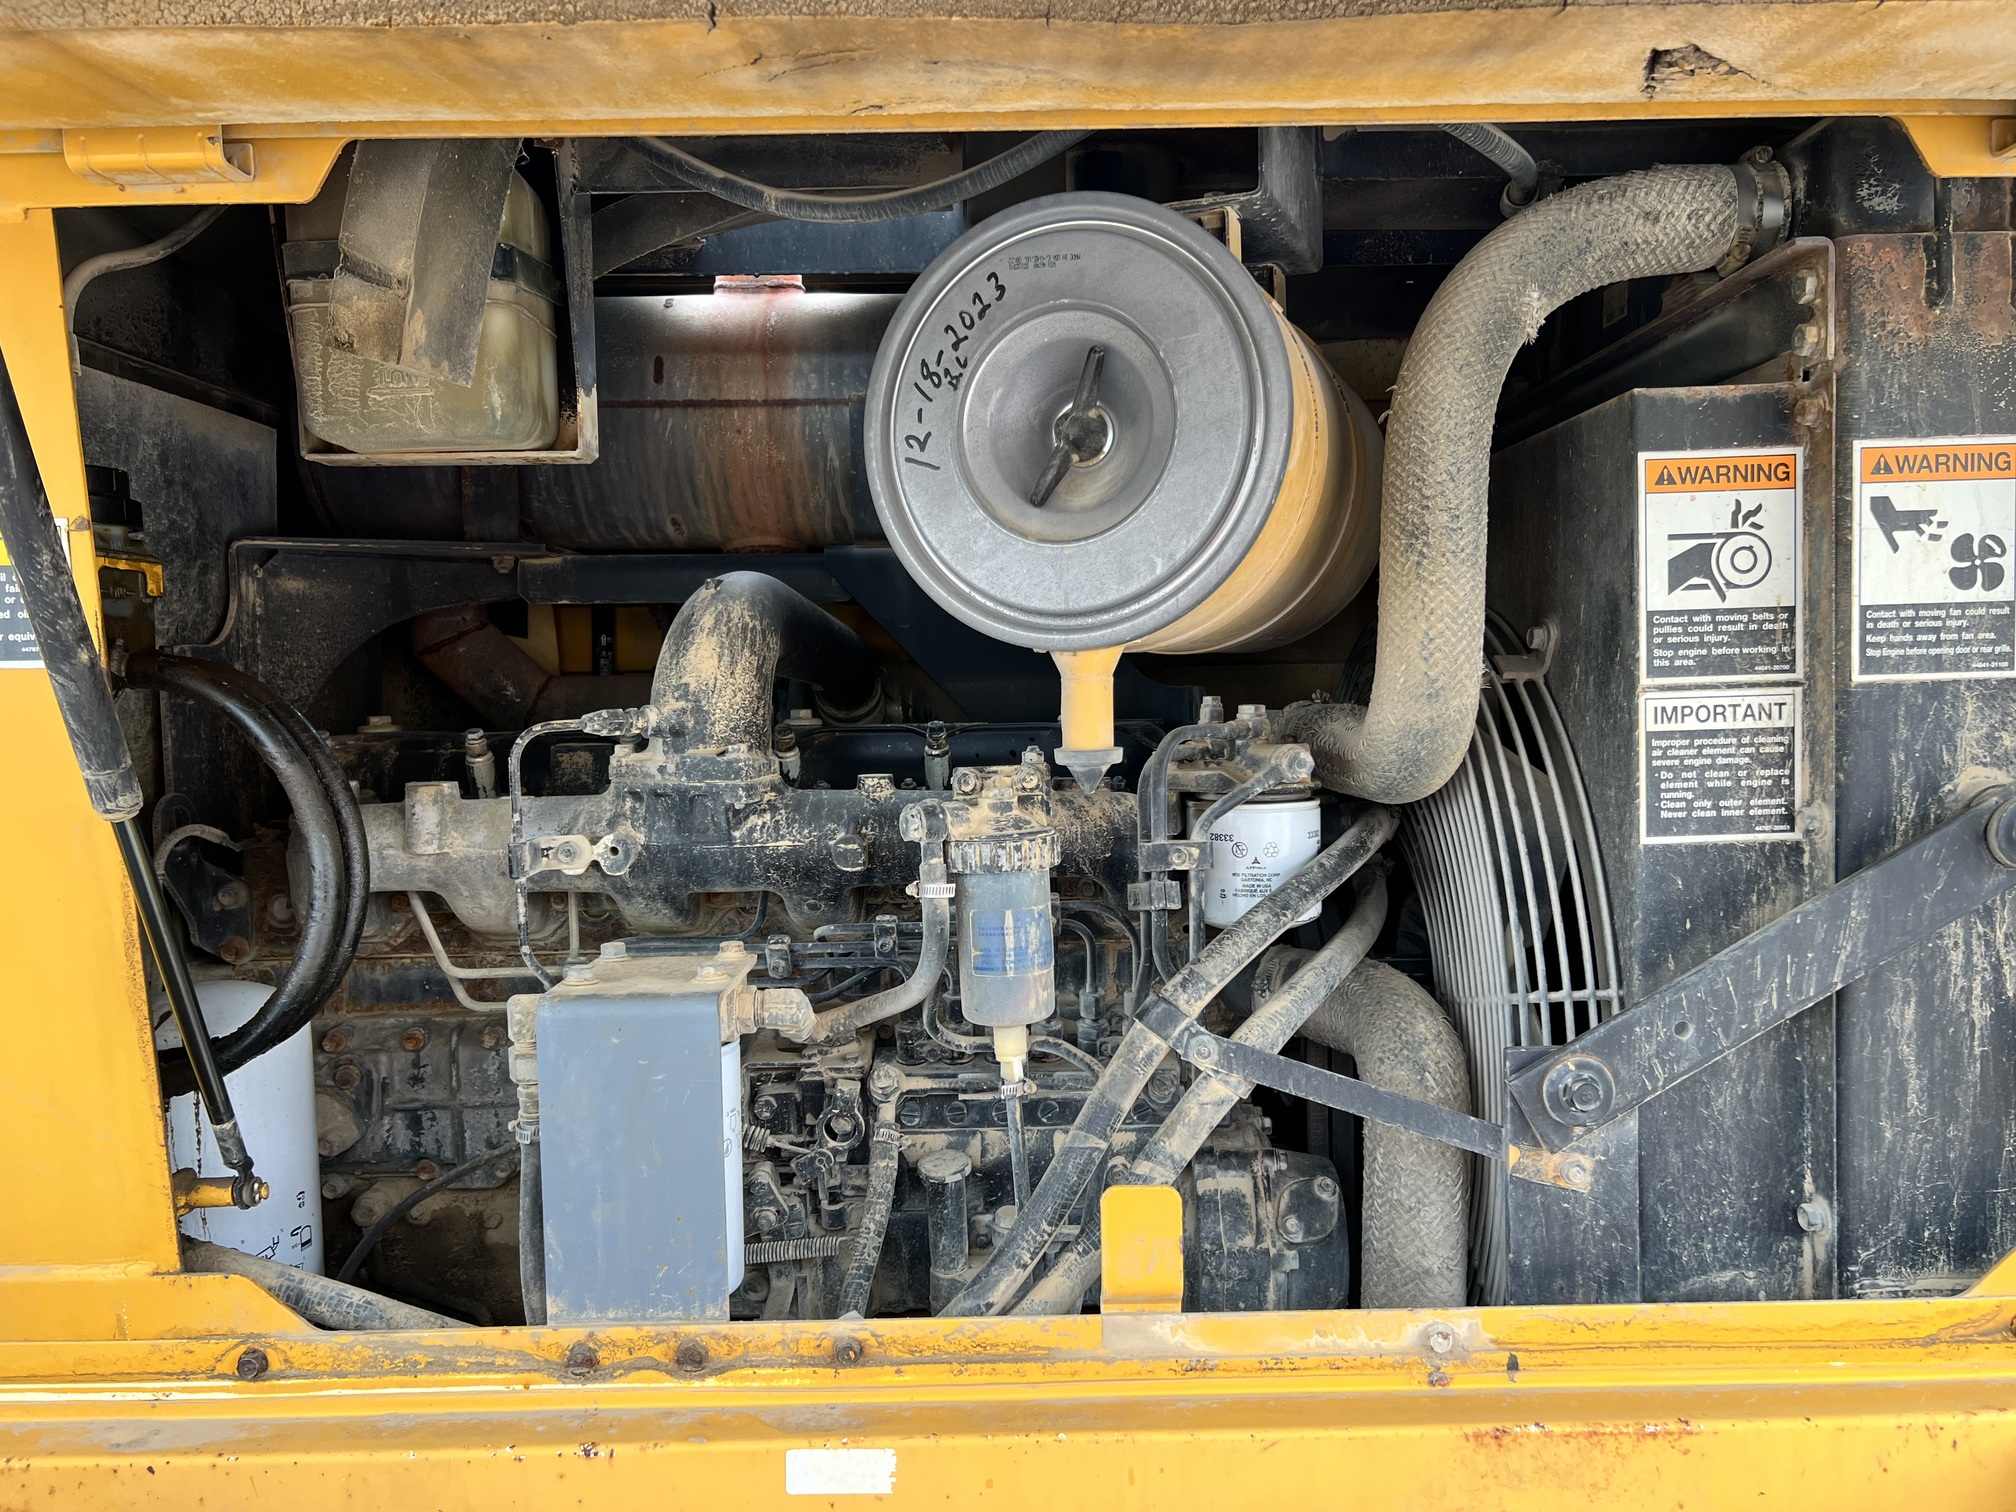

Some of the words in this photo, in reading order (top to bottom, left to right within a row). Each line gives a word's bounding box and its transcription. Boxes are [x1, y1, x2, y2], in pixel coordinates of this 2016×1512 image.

[905, 271, 1006, 470] 12-18-2023
[1893, 451, 2012, 474] WARNING
[1677, 462, 1790, 485] WARNING
[4, 596, 16, 604] or
[1653, 615, 1688, 624] Contact
[1692, 614, 1712, 622] with
[1716, 612, 1748, 622] moving
[1752, 612, 1775, 620] belts
[1779, 612, 1789, 620] or
[1866, 610, 1896, 619] Contact
[1899, 609, 1916, 618] with
[1918, 608, 1946, 618] moving
[1949, 608, 1962, 616] fan
[1965, 607, 1986, 616] could
[1989, 606, 2010, 614] result
[1653, 625, 1683, 634] pullies
[1688, 624, 1713, 632] could
[1718, 623, 1744, 632] result
[1748, 622, 1758, 630] in
[1762, 622, 1789, 630] death
[1877, 620, 1900, 628] death
[1914, 619, 1942, 628] serious
[1946, 618, 1970, 628] injury.
[8, 632, 36, 642] equiv
[1653, 636, 1664, 644] or
[1667, 634, 1700, 643] serious
[1704, 633, 1731, 642] injury.
[1866, 634, 1887, 644] Keep
[1890, 633, 1914, 642] hands
[1916, 634, 1937, 642] away
[1940, 632, 1958, 640] from
[1962, 631, 1974, 640] fan
[1977, 632, 1997, 640] area.
[1653, 648, 1674, 658] Stop
[1678, 648, 1708, 657] engine
[1712, 646, 1740, 655] before
[1742, 646, 1777, 656] working
[1782, 645, 1790, 653] in
[1866, 647, 1882, 657] Stop
[1882, 647, 1905, 658] Engine
[1906, 646, 1927, 655] before
[1928, 646, 1954, 656] opening
[1956, 646, 1971, 654] door
[1972, 646, 1980, 654] or
[1980, 646, 1994, 654] rear
[1653, 659, 1670, 667] this
[1653, 702, 1787, 725] IMPORTANT
[1652, 738, 1691, 748] Improper
[1694, 736, 1738, 746] procedure
[1741, 735, 1751, 744] of
[1754, 734, 1790, 744] cleaning
[1652, 748, 1664, 757] air
[1667, 747, 1699, 756] cleaner
[1702, 746, 1736, 756] element
[1740, 746, 1756, 754] can
[1760, 745, 1785, 754] cause
[1684, 757, 1712, 767] engine
[1716, 756, 1752, 766] damage.
[1660, 771, 1674, 780] Do
[1682, 770, 1697, 778] not
[1704, 769, 1730, 778] clean
[1756, 767, 1790, 777] replace
[1660, 779, 1698, 789] element
[1706, 778, 1732, 788] while
[1740, 778, 1773, 788] engine
[1781, 777, 1790, 785] is
[1660, 790, 1695, 800] running.
[1660, 800, 1686, 809] Clean
[1693, 799, 1712, 809] only
[1719, 798, 1743, 807] outer
[1750, 797, 1788, 806] element.
[1660, 810, 1688, 819] Never
[1692, 808, 1716, 818] clean
[1721, 808, 1745, 817] inner
[1749, 807, 1788, 816] element.
[1210, 832, 1234, 842] 33382
